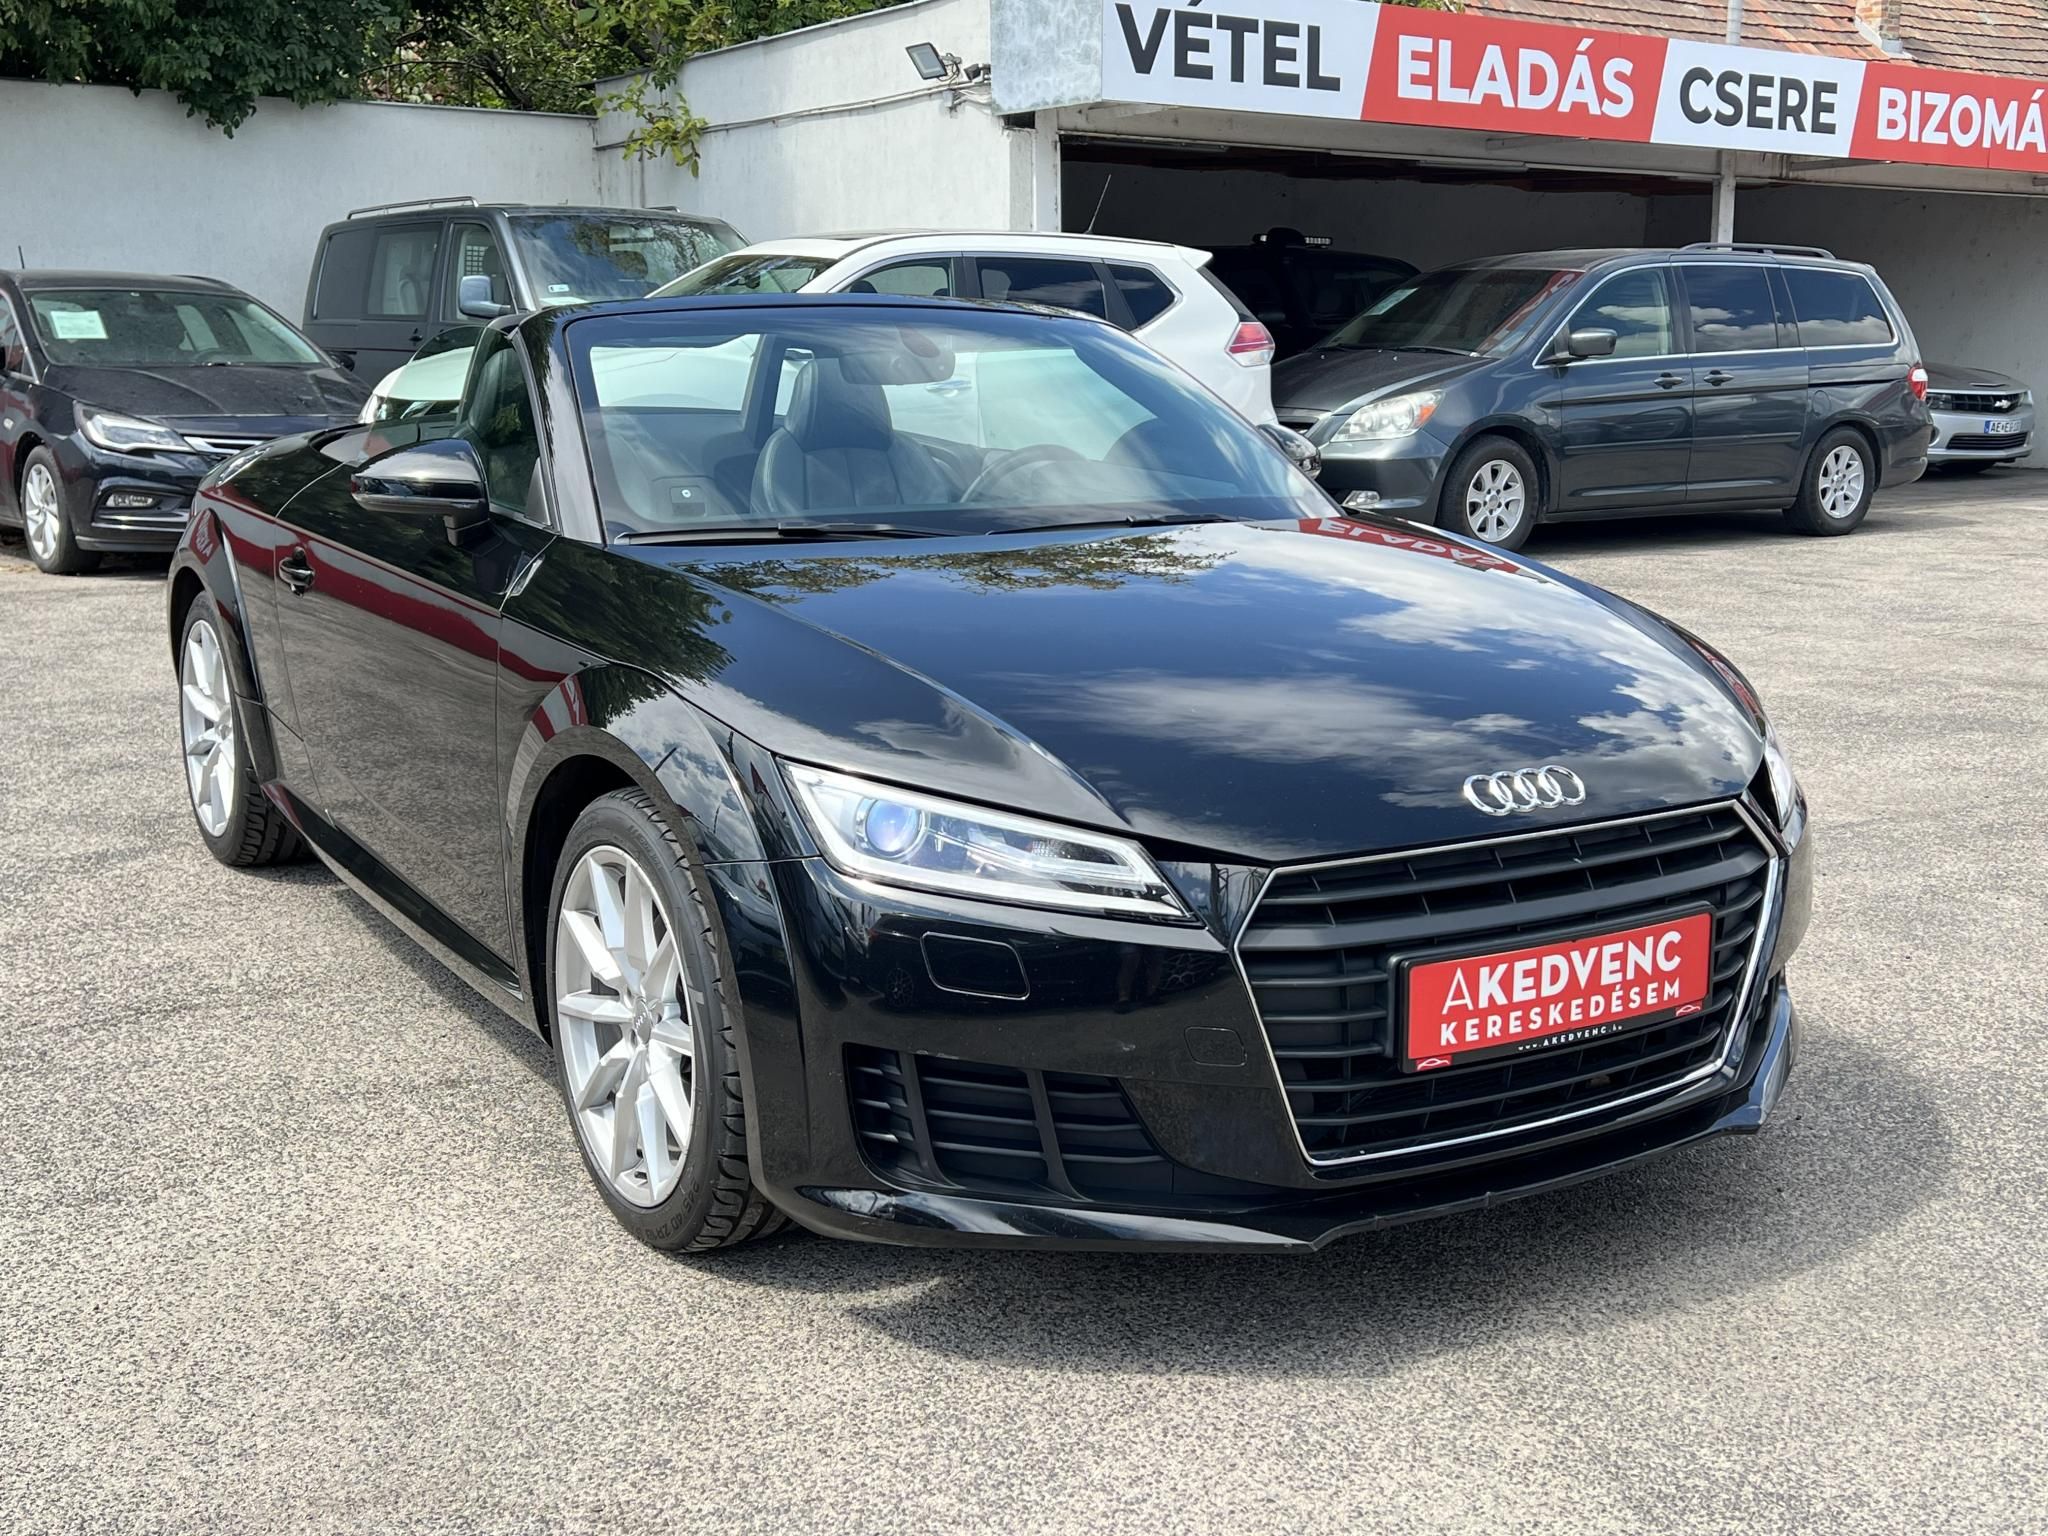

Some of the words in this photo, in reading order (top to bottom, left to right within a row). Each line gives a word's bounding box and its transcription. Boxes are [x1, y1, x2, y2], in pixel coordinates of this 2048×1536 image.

[1115, 0, 1341, 92] VÉTEL
[1397, 35, 1635, 119] ELADÁS
[1680, 66, 1838, 135] CSERE
[1876, 86, 2048, 153] BIZOMÁ
[1440, 977, 1681, 1047] KERESKEDÉSEM
[1441, 930, 1682, 1015] AKEDVENC
